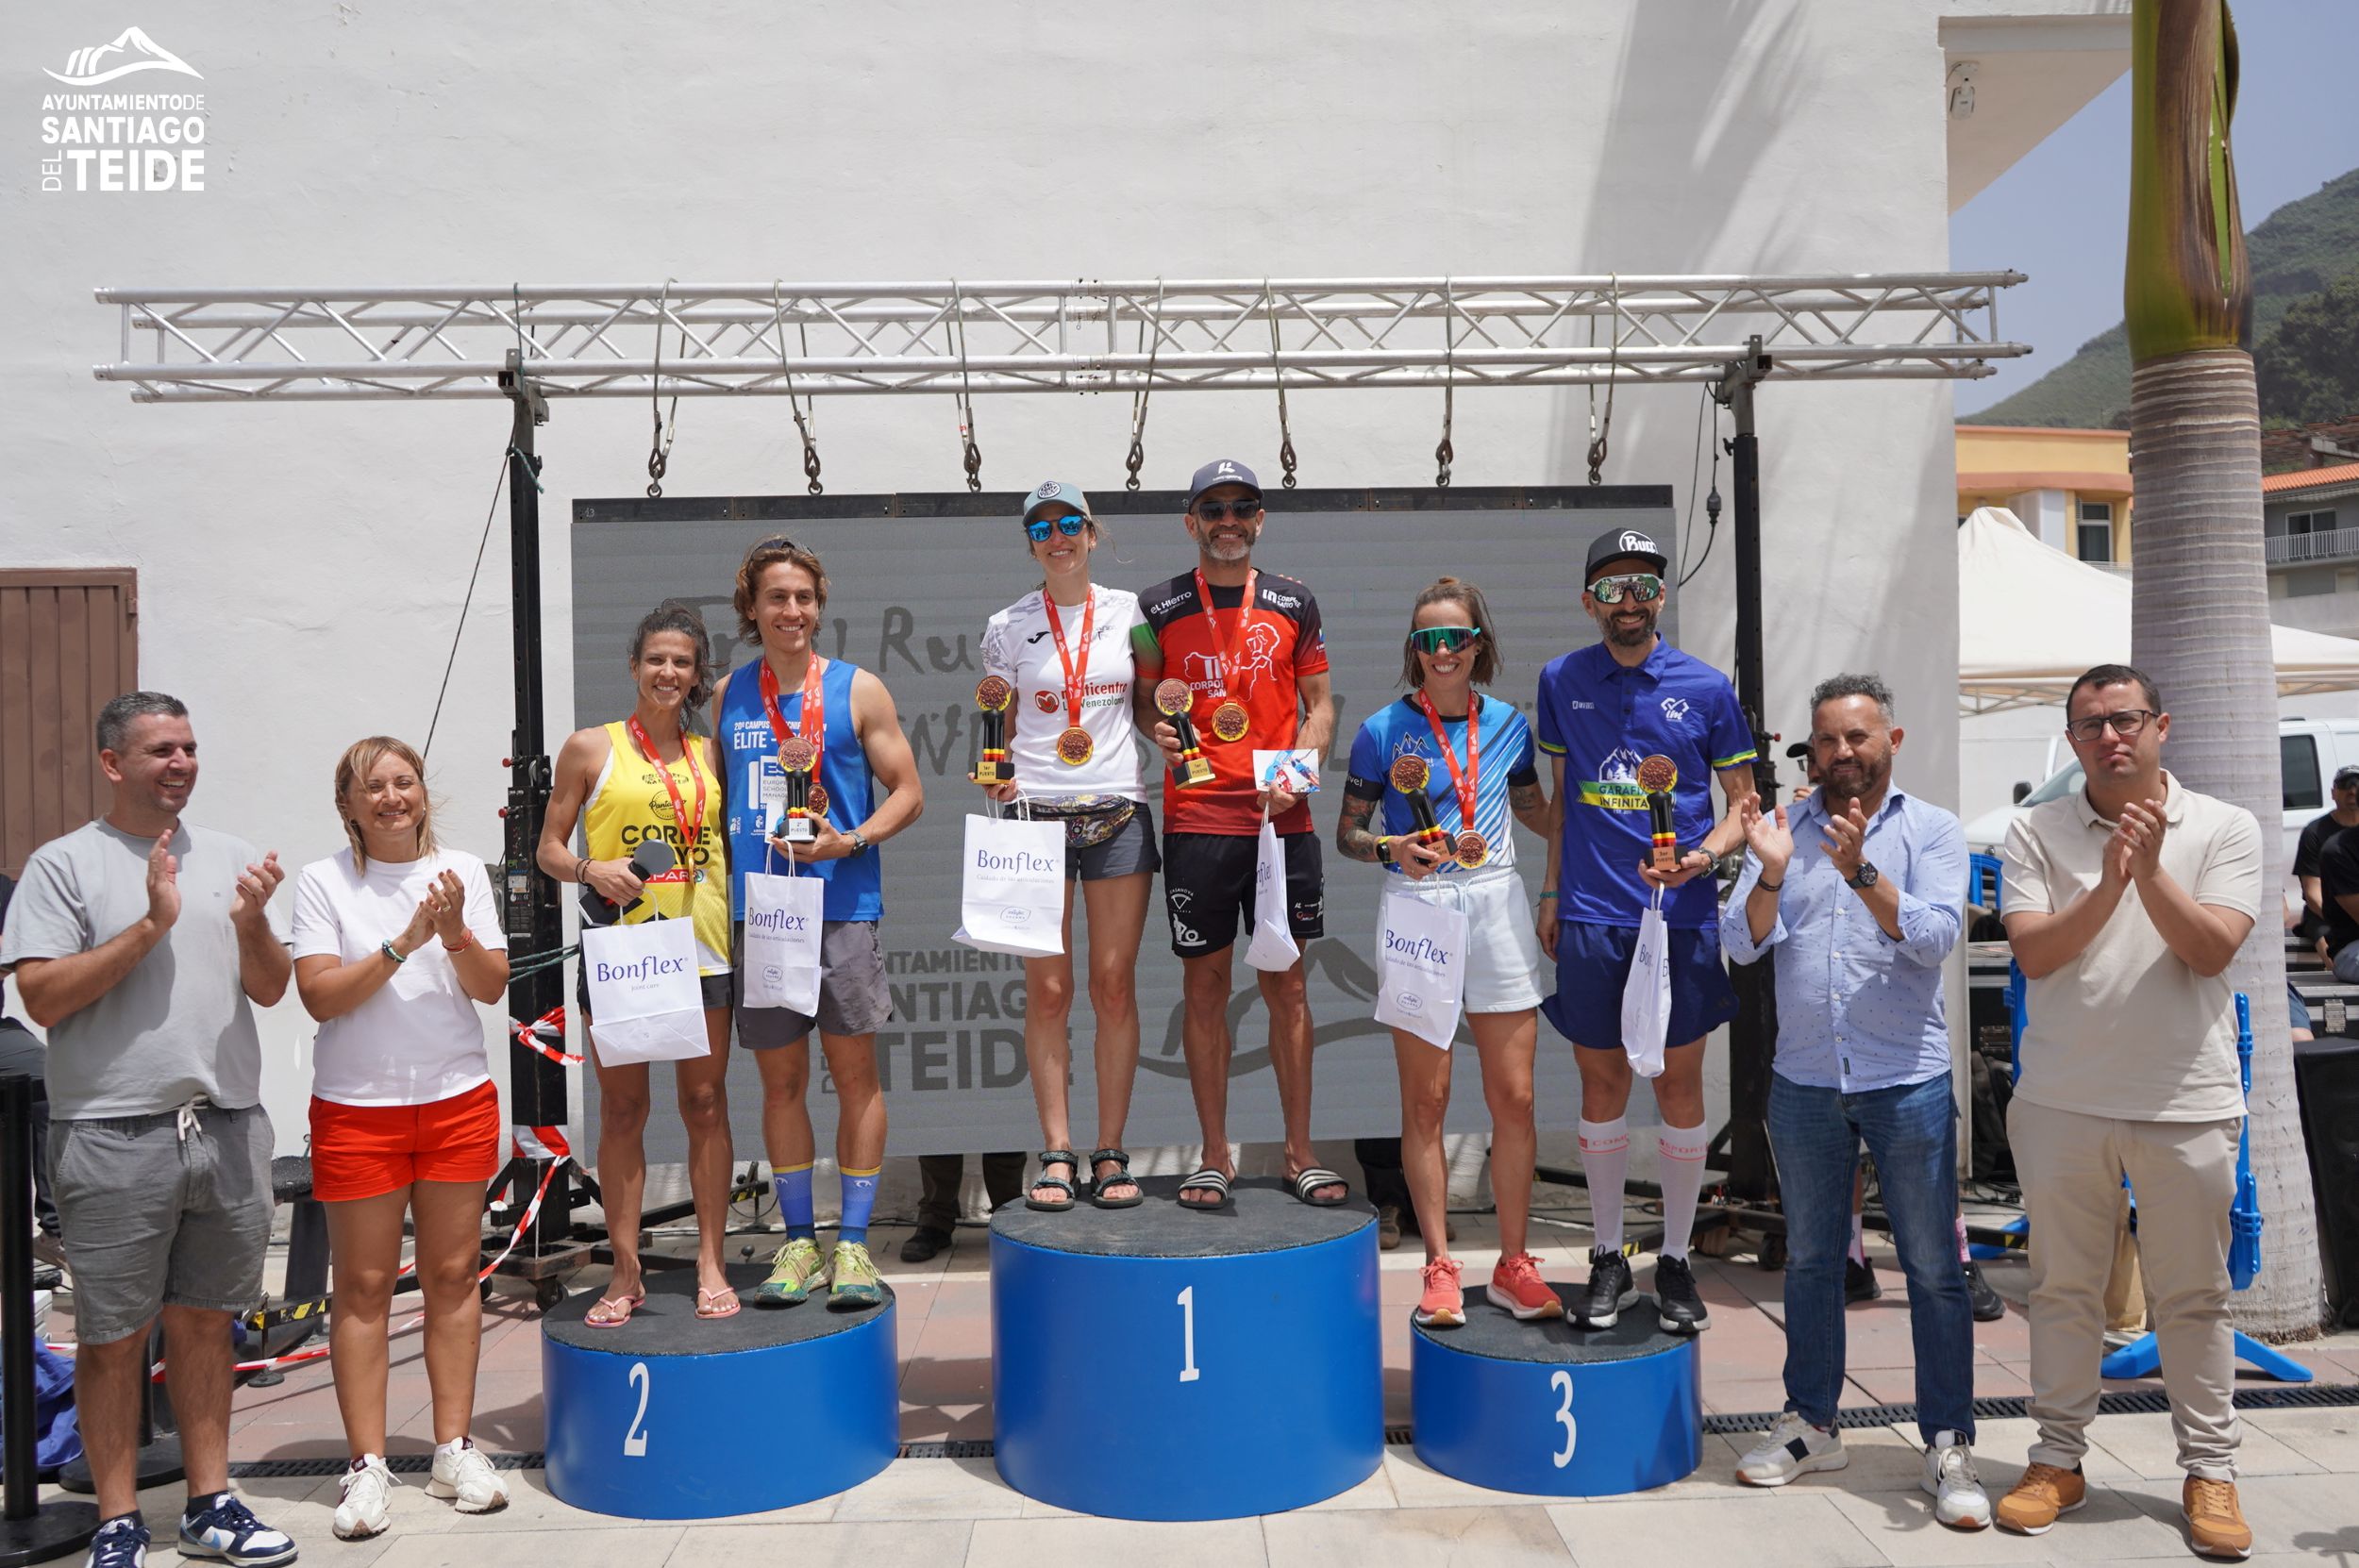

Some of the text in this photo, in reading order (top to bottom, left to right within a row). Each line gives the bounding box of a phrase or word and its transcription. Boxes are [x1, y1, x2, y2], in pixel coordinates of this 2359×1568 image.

[1190, 679, 1224, 691] CORPO
[1208, 689, 1227, 698] SAN
[745, 721, 771, 729] CAMPUS
[734, 731, 767, 750] ÉLITE
[1599, 785, 1646, 795] GARAFI
[1599, 796, 1648, 809] INFINITA
[977, 849, 1055, 875] Bonflex
[748, 907, 806, 933] Bonflex
[1385, 928, 1448, 964] Bonflex
[596, 956, 684, 982] Bonflex
[890, 979, 1027, 1023] NTIAG
[874, 1028, 1073, 1091] TEID
[1177, 1286, 1200, 1382] 1
[624, 1363, 650, 1458] 2
[1550, 1370, 1578, 1468] 3
